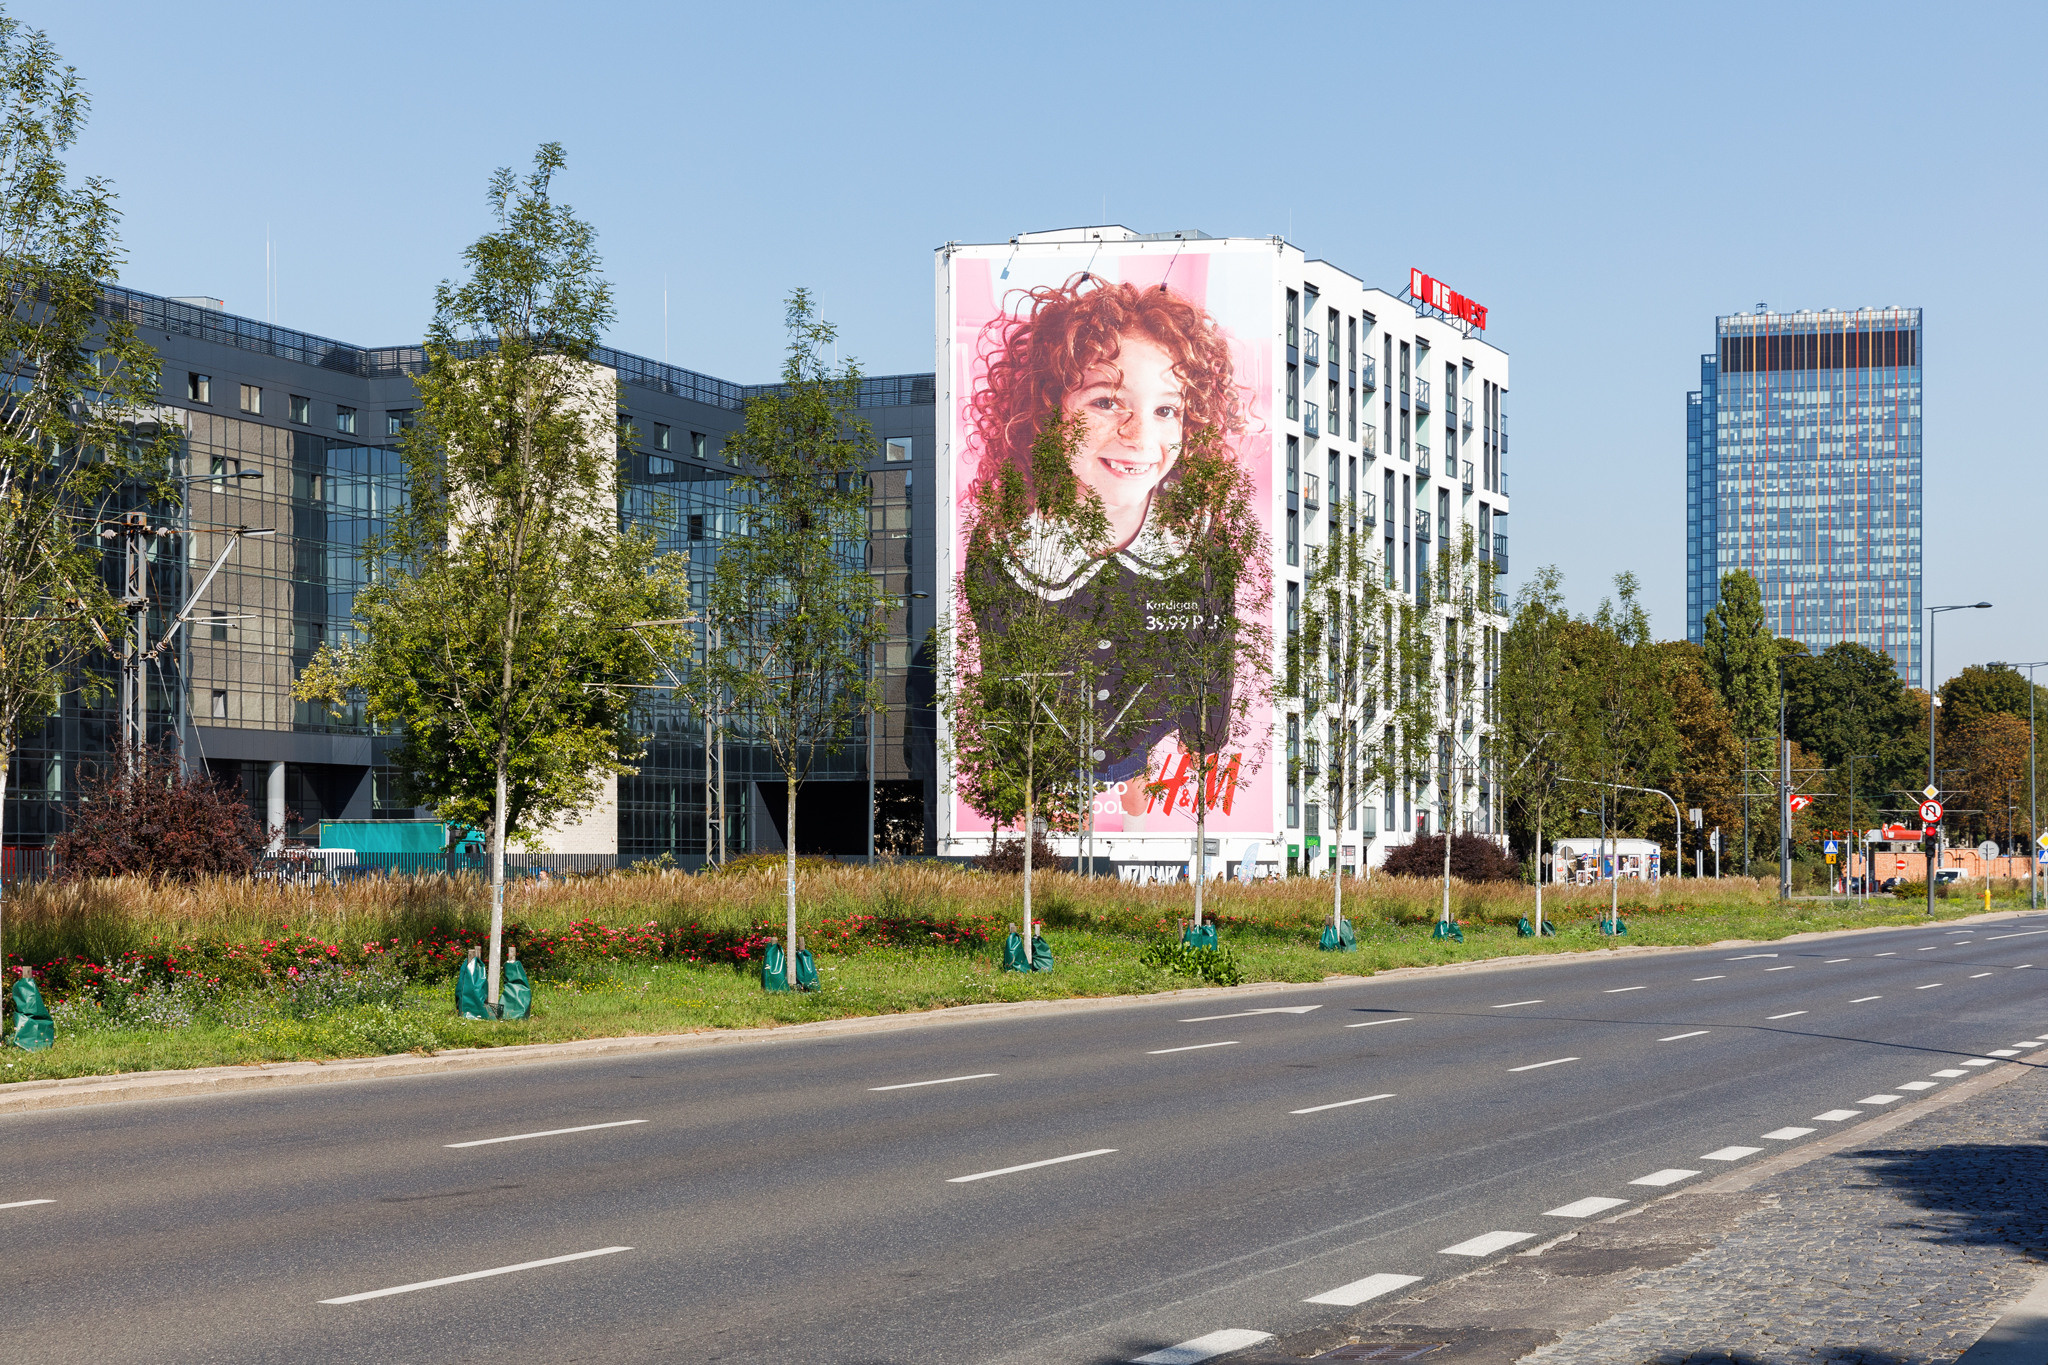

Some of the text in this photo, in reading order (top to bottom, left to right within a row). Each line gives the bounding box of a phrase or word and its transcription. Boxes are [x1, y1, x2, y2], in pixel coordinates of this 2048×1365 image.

[1146, 614, 1227, 631] 39,99 PN
[1104, 781, 1128, 796] TO
[1145, 752, 1242, 817] H&M
